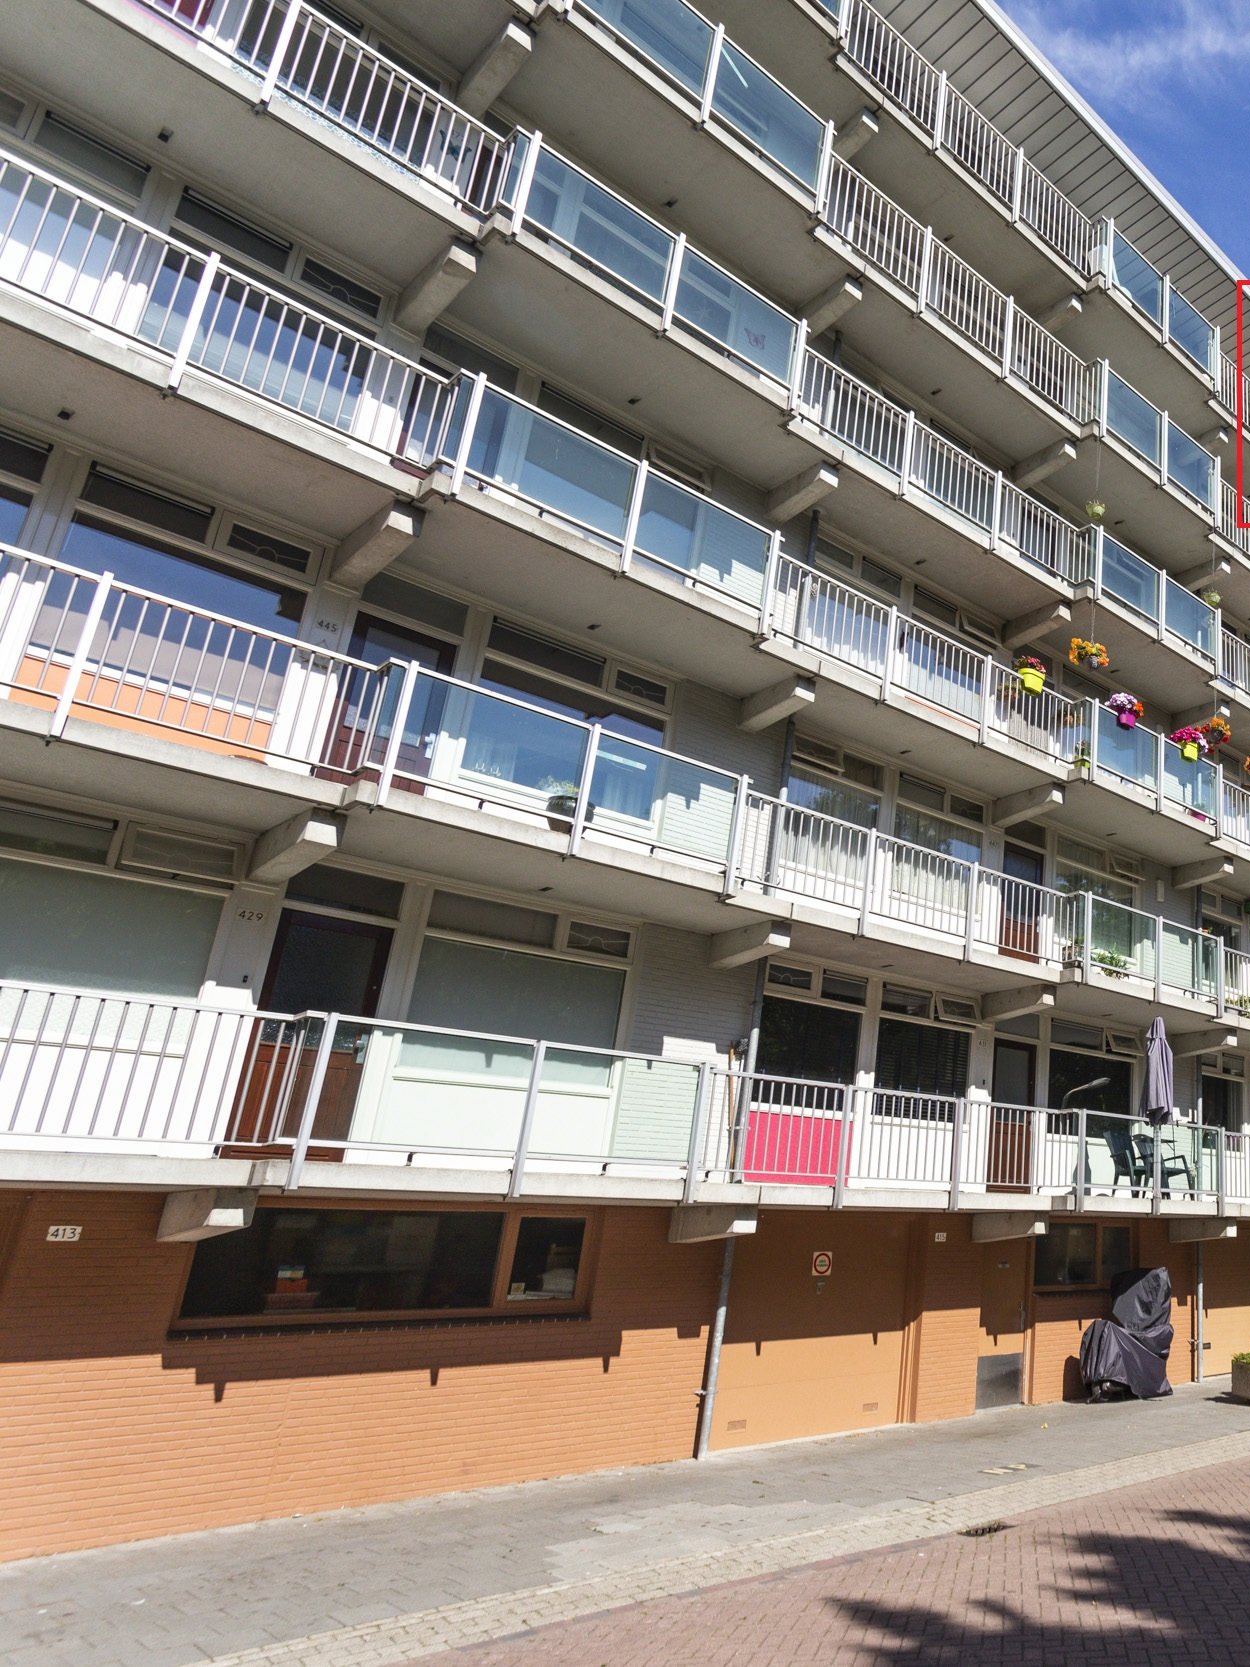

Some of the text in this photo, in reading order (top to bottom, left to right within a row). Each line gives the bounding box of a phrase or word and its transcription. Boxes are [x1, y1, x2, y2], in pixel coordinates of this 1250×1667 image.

[318, 620, 337, 632] 445
[238, 910, 264, 921] 429
[50, 1227, 77, 1240] 413
